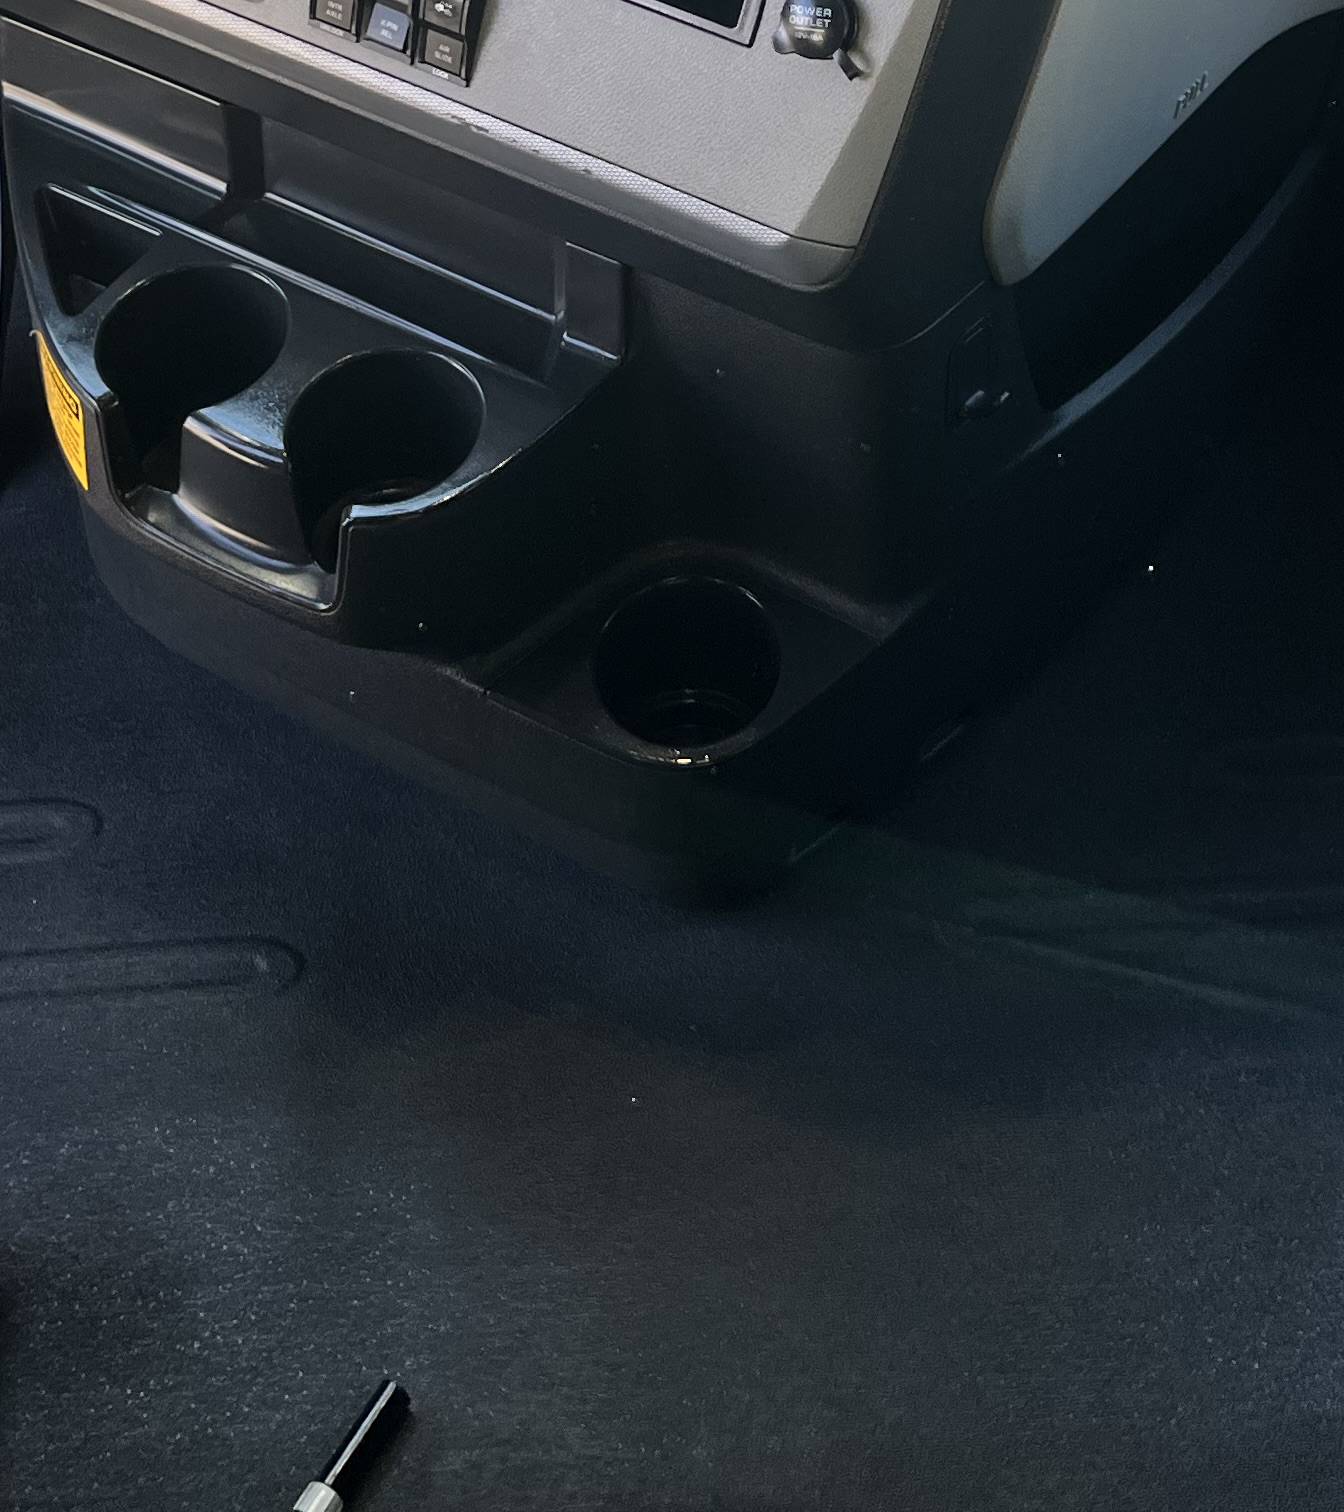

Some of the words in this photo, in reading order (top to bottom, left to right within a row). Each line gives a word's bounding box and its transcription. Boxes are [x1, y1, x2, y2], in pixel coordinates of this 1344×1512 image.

[326, 8, 343, 20] AXLE
[789, 4, 832, 18] POWER
[789, 14, 832, 28] OUTLET
[434, 51, 453, 64] SLIDE
[432, 68, 449, 80] LOCK
